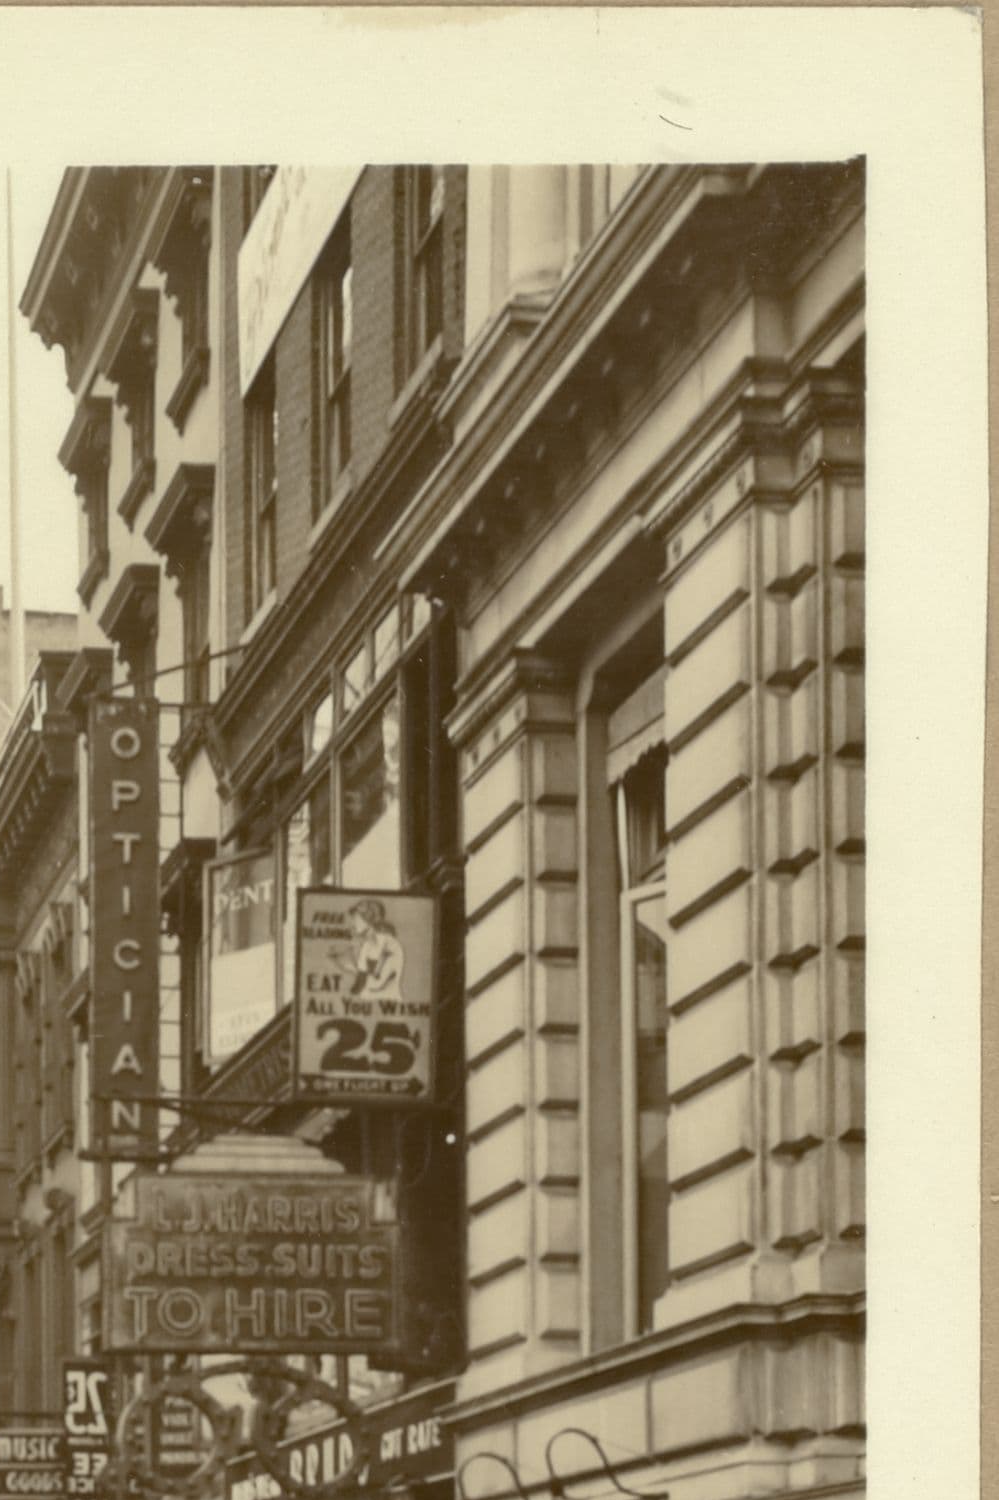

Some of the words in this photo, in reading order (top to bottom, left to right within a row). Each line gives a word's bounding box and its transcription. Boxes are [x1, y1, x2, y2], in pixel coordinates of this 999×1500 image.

[110, 726, 143, 1128] OPTICIAN
[307, 973, 341, 993] EAT
[306, 997, 337, 1016] ALL
[343, 998, 373, 1016] YOU
[379, 1000, 431, 1016] WISH
[215, 1194, 361, 1234] HARRIS
[126, 1241, 265, 1278] DRESS
[270, 1241, 386, 1280] SUITS
[124, 1285, 203, 1345] TO
[224, 1286, 390, 1339] HIRE
[406, 1417, 442, 1456] RATE
